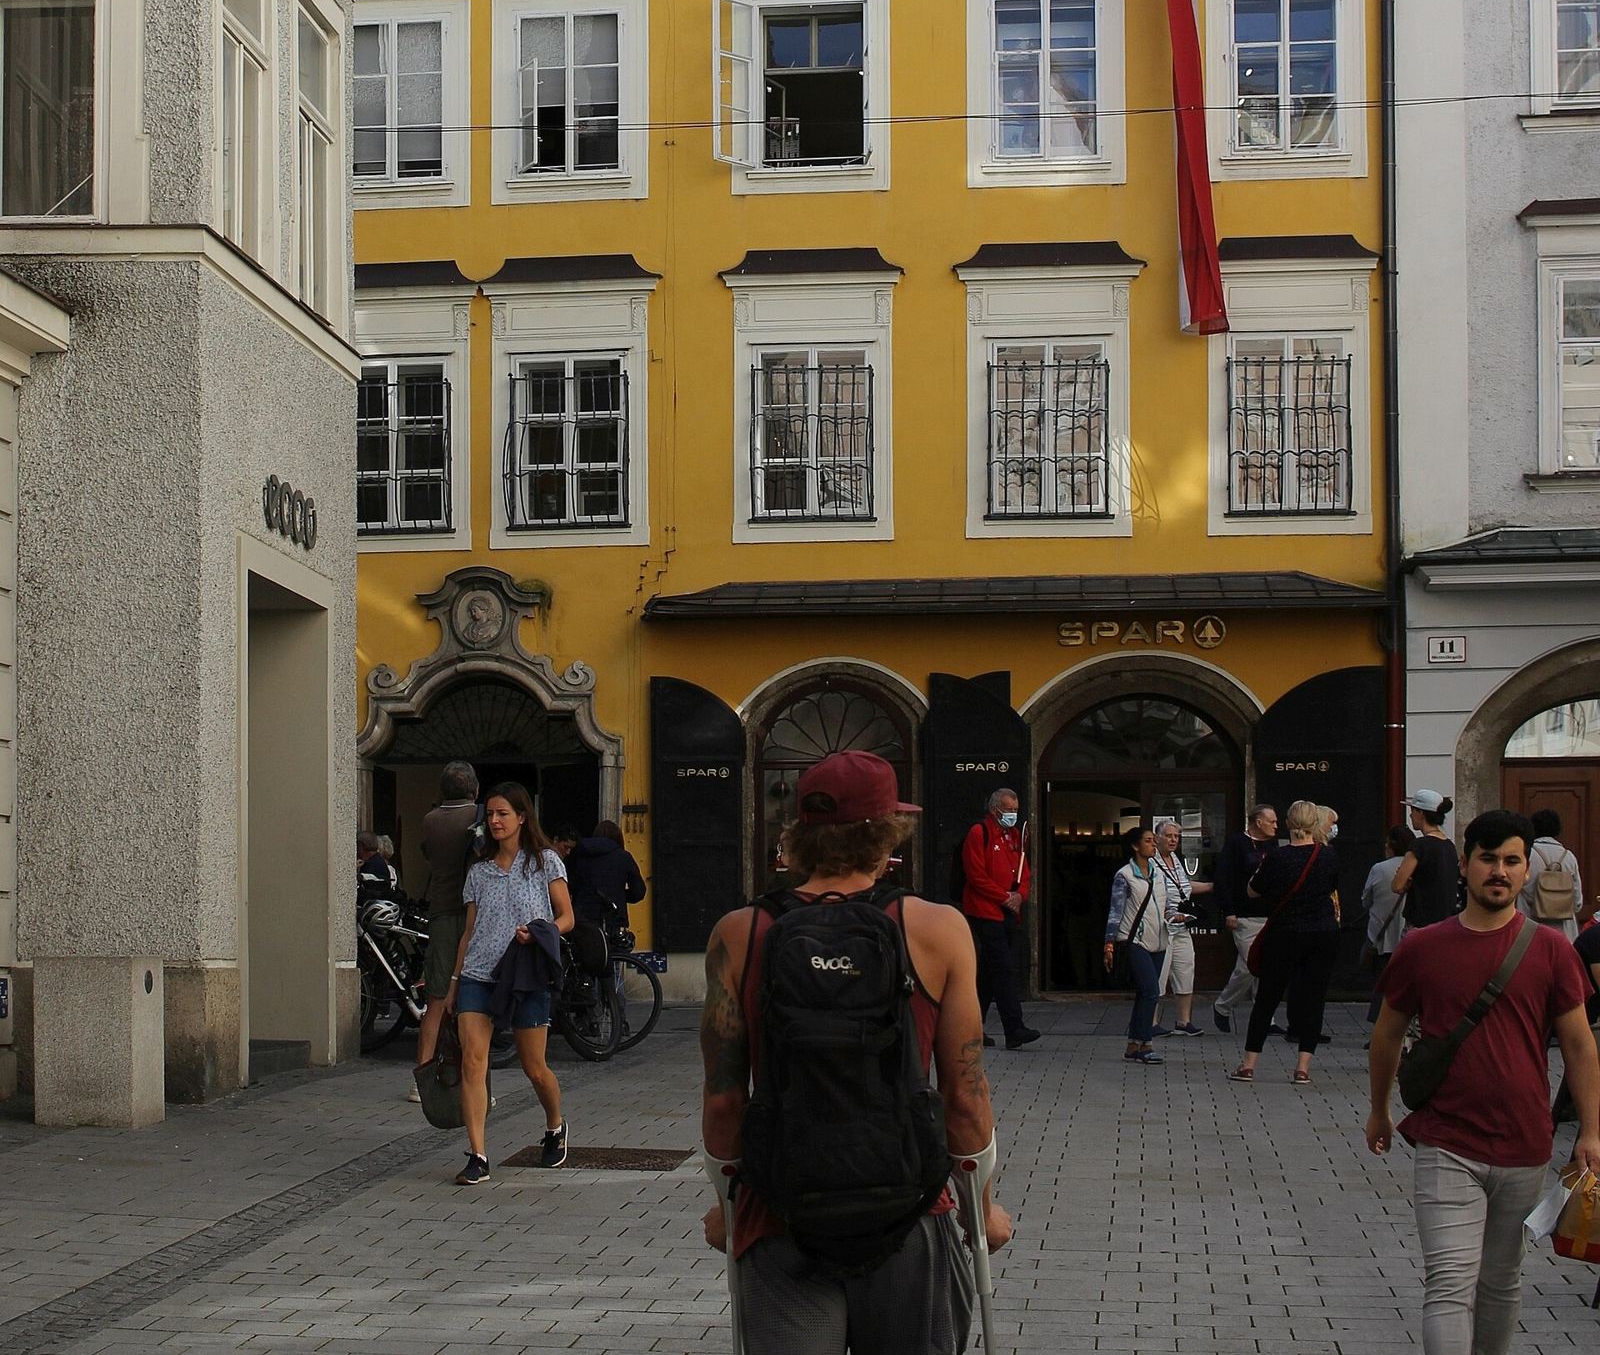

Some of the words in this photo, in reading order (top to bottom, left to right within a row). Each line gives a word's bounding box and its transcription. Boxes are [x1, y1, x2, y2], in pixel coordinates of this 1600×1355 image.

[1058, 621, 1186, 646] SPAR
[1437, 640, 1455, 653] 11
[955, 763, 997, 772] SPAR
[1275, 762, 1317, 771] SPAR
[676, 768, 717, 777] SPAR
